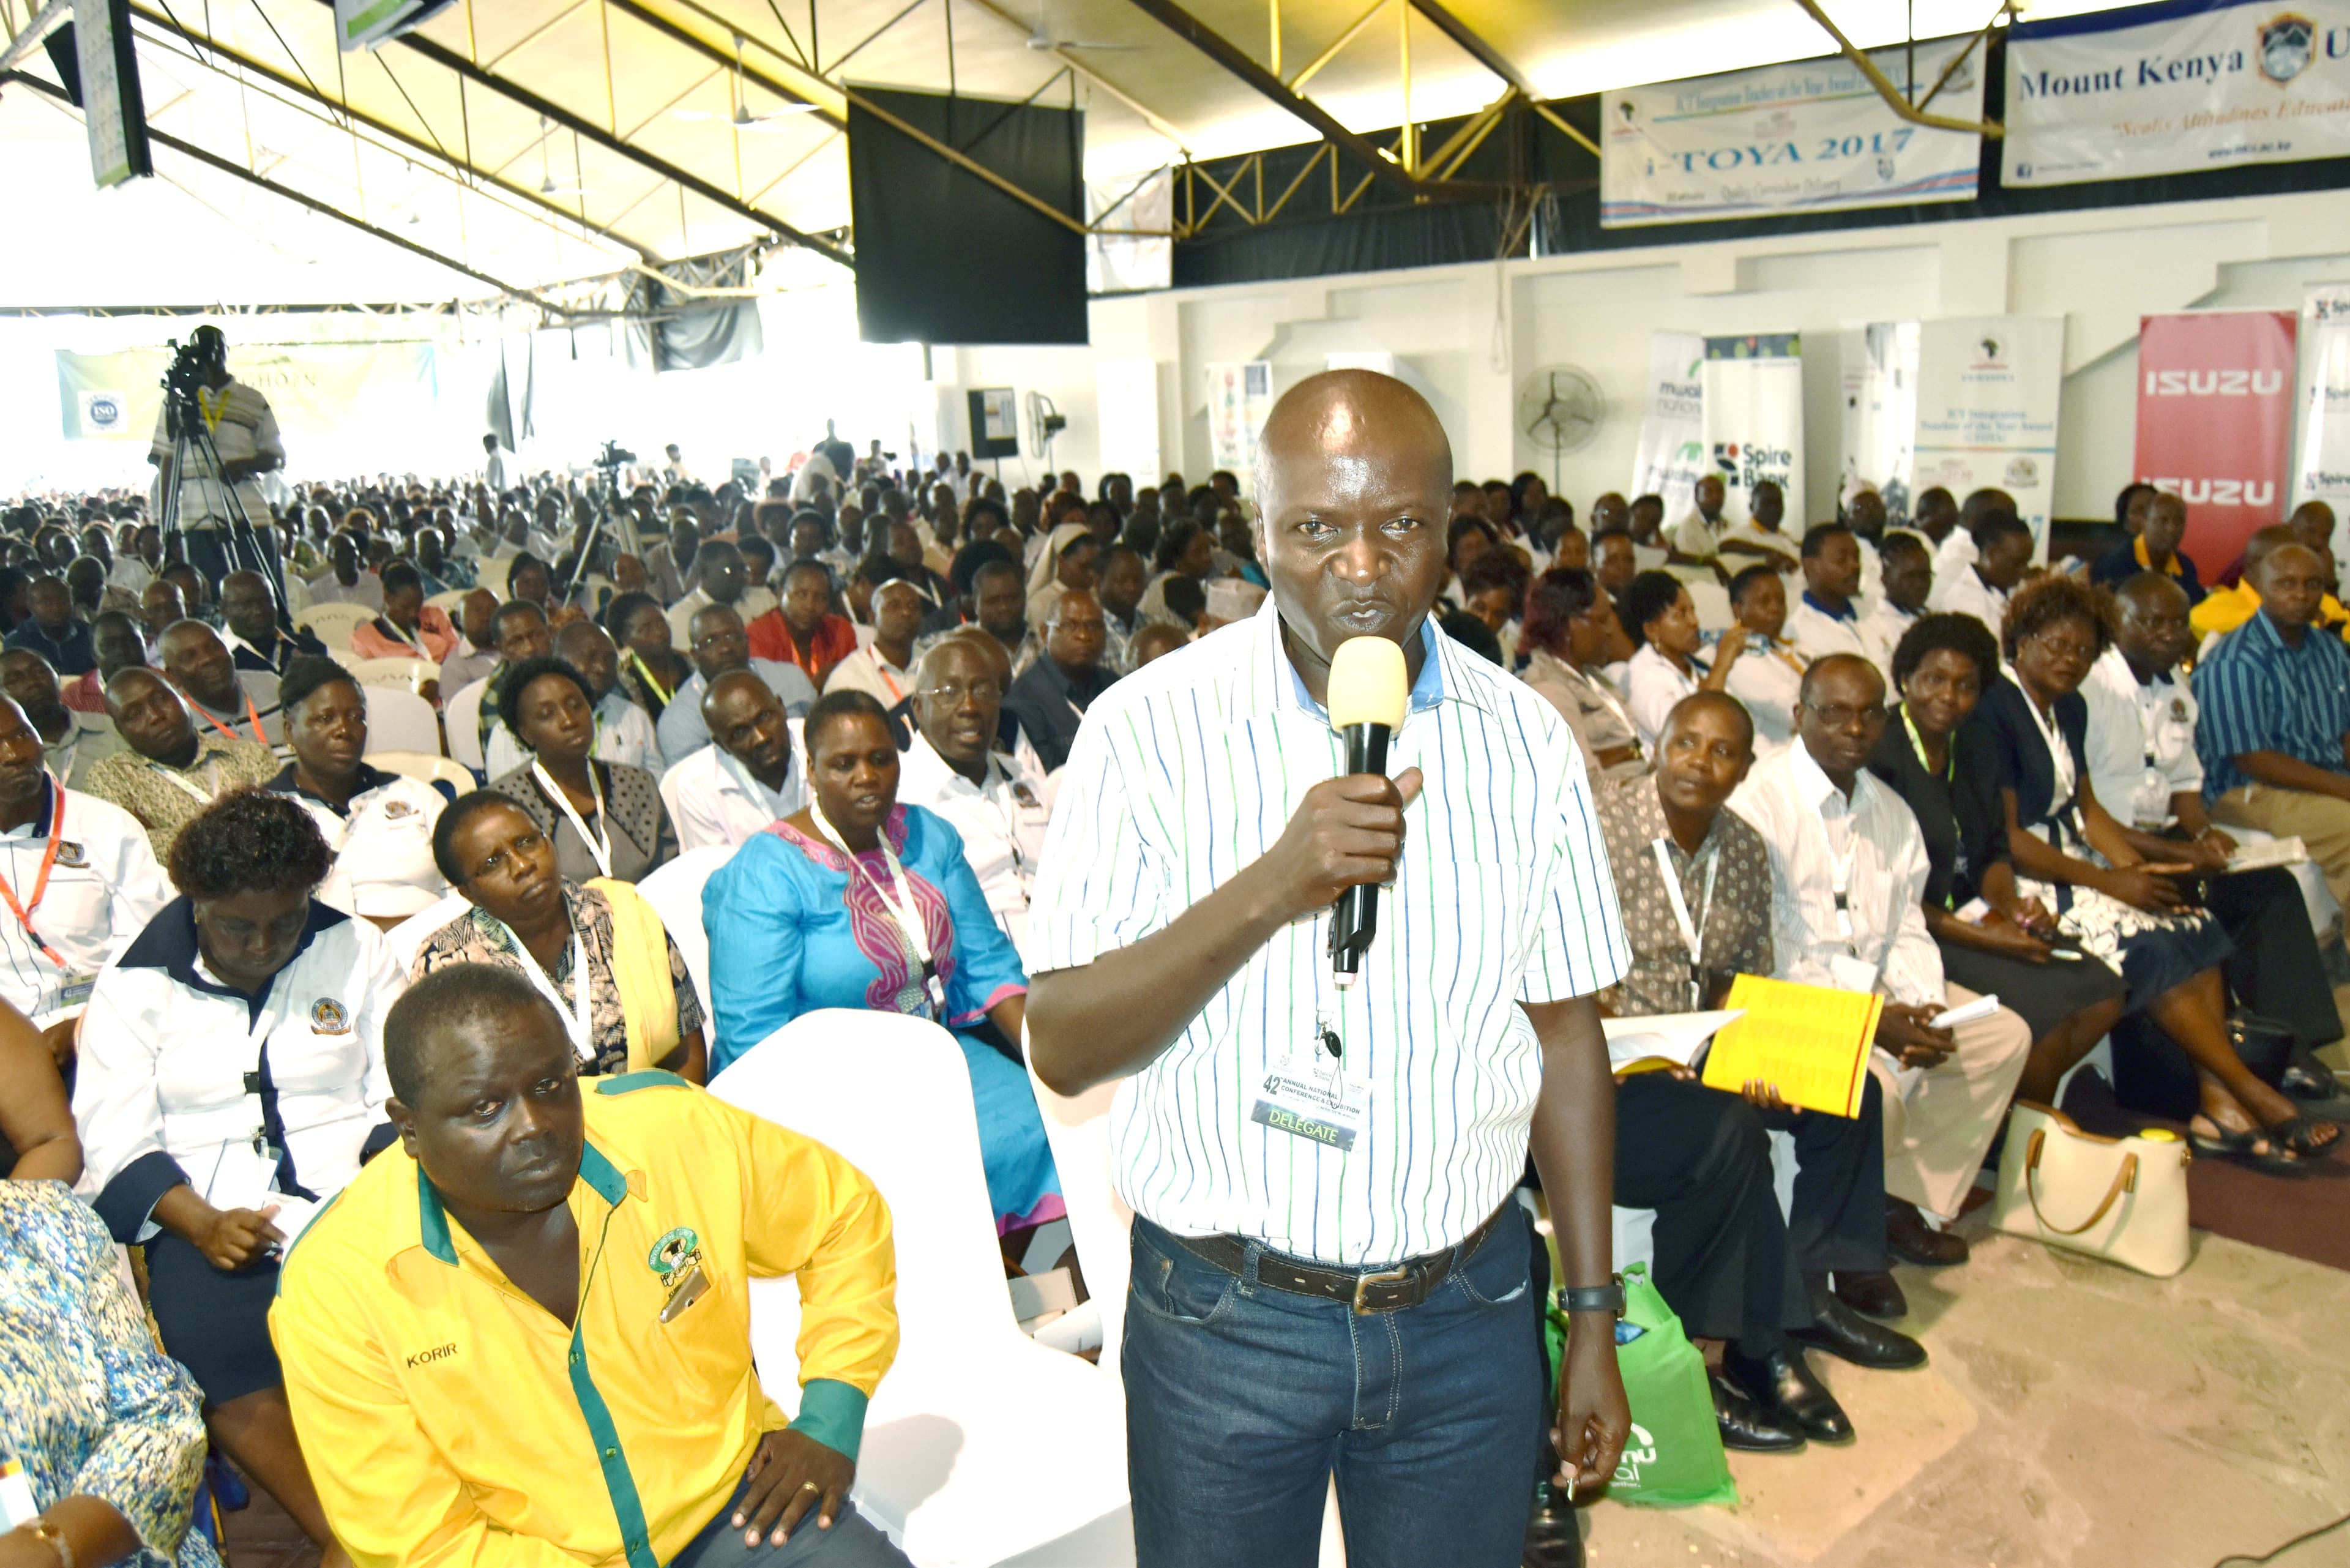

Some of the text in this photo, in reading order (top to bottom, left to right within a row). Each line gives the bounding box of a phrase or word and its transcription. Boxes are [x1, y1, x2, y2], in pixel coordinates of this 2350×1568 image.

[2020, 65, 2124, 100] Mount
[2139, 49, 2244, 86] Kenya
[1816, 127, 1914, 160] 2017
[2146, 369, 2283, 396] ISUZU
[1743, 442, 1792, 468] Spire
[1281, 1086, 1320, 1102] CONFERENCE
[1283, 1078, 1307, 1090] ANNUAL
[1309, 1086, 1338, 1100] NATIONAL
[1268, 1110, 1338, 1143] DELEGATE
[406, 1342, 459, 1368] KORIR
